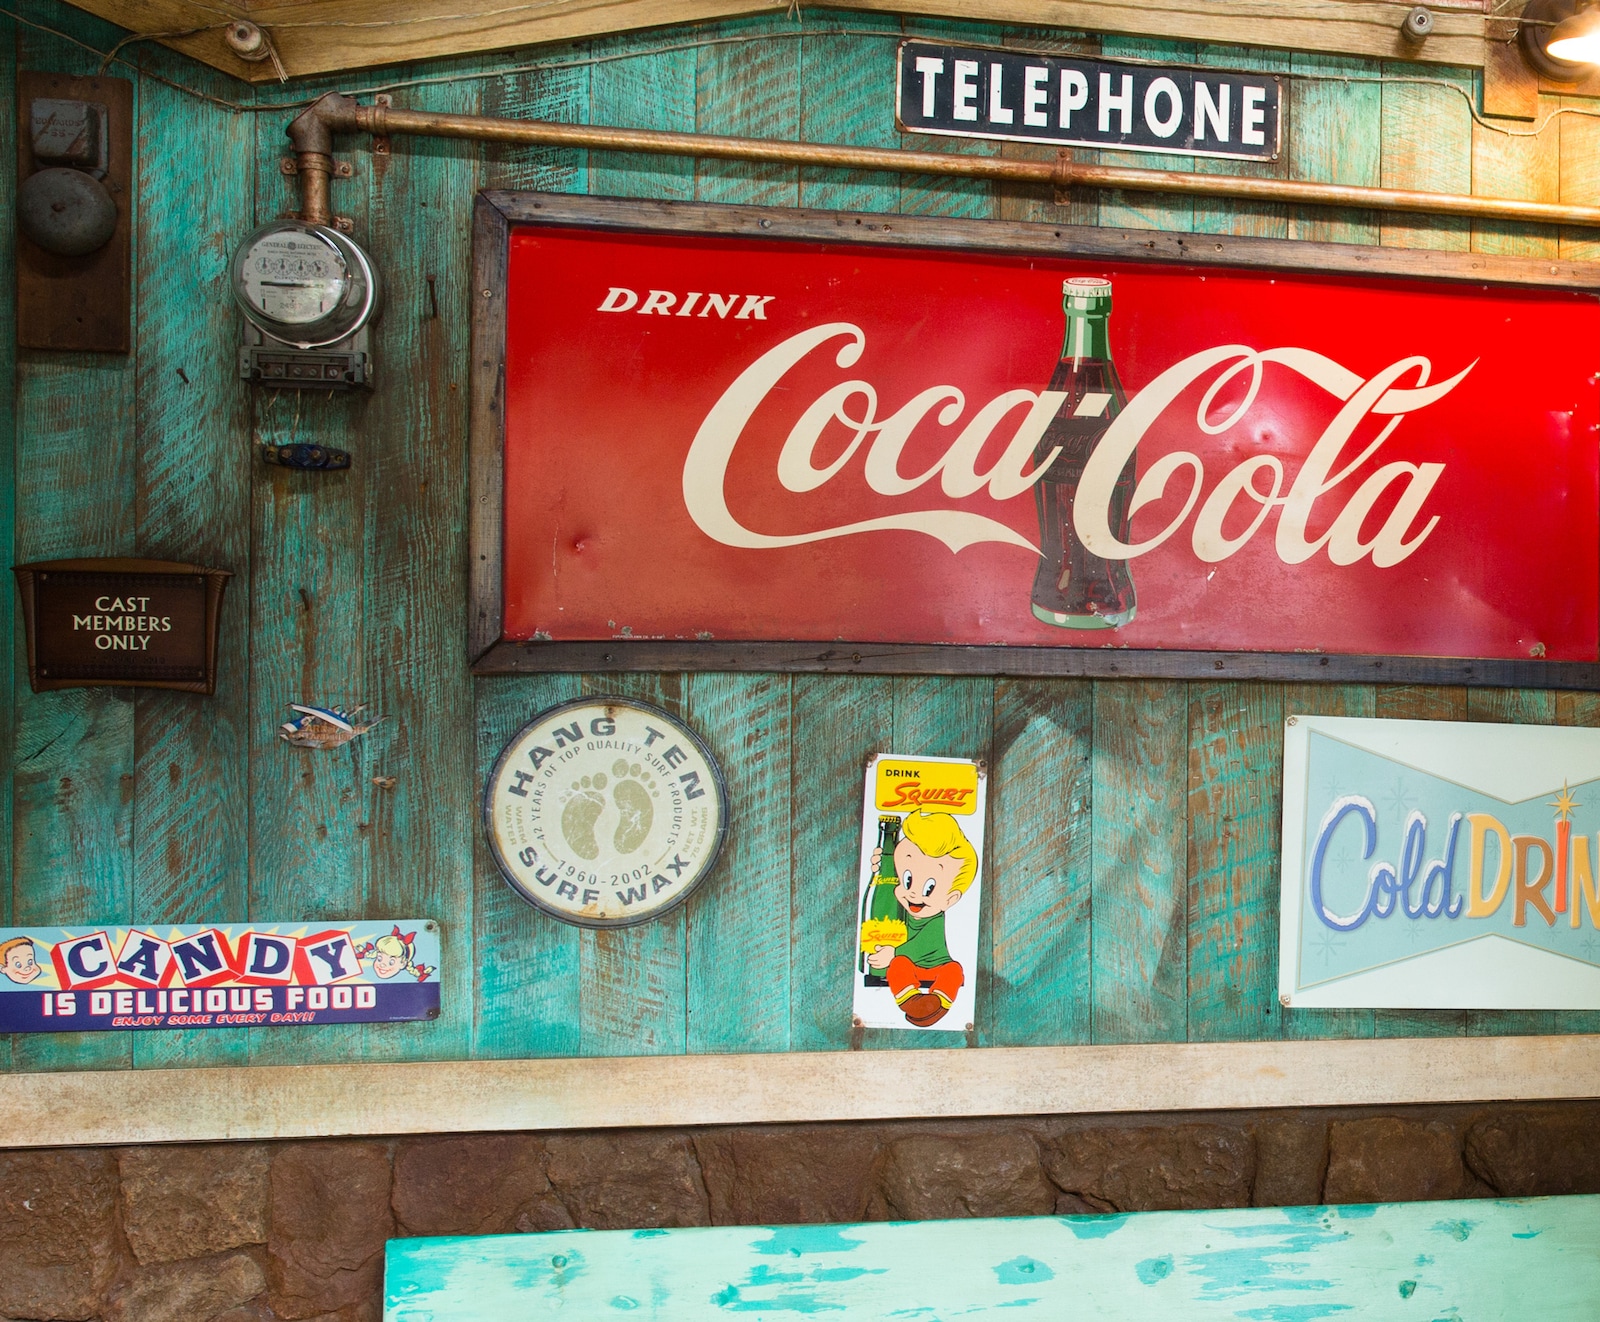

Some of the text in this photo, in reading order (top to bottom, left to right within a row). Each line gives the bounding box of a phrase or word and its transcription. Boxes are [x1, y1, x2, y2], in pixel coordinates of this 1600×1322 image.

[915, 56, 1266, 146] TELEPHONE
[597, 286, 776, 322] DRINK
[94, 596, 150, 612] CAST
[72, 614, 172, 632] MEMBERS
[94, 634, 151, 650] ONLY
[507, 717, 706, 802] HANG TEN
[885, 769, 921, 778] DRINK
[531, 782, 548, 822] YEARS
[544, 764, 559, 779] OF
[558, 745, 582, 764] TOP
[586, 739, 642, 755] QUALITY
[644, 752, 673, 778] SURF
[667, 781, 683, 846] PRODUCTS
[504, 804, 517, 847] WATER
[515, 805, 528, 844] WARM
[683, 827, 695, 853] NET
[697, 806, 708, 846] GRAMS
[518, 846, 691, 907] SURF WAX
[557, 860, 653, 887] 1960-2002
[1309, 794, 1464, 933] Cold
[68, 934, 348, 980] CANDY
[42, 985, 377, 1016] IS DELICIOUS FOOD
[112, 1010, 316, 1026] ENJOY SOME EVERY DAY!!
